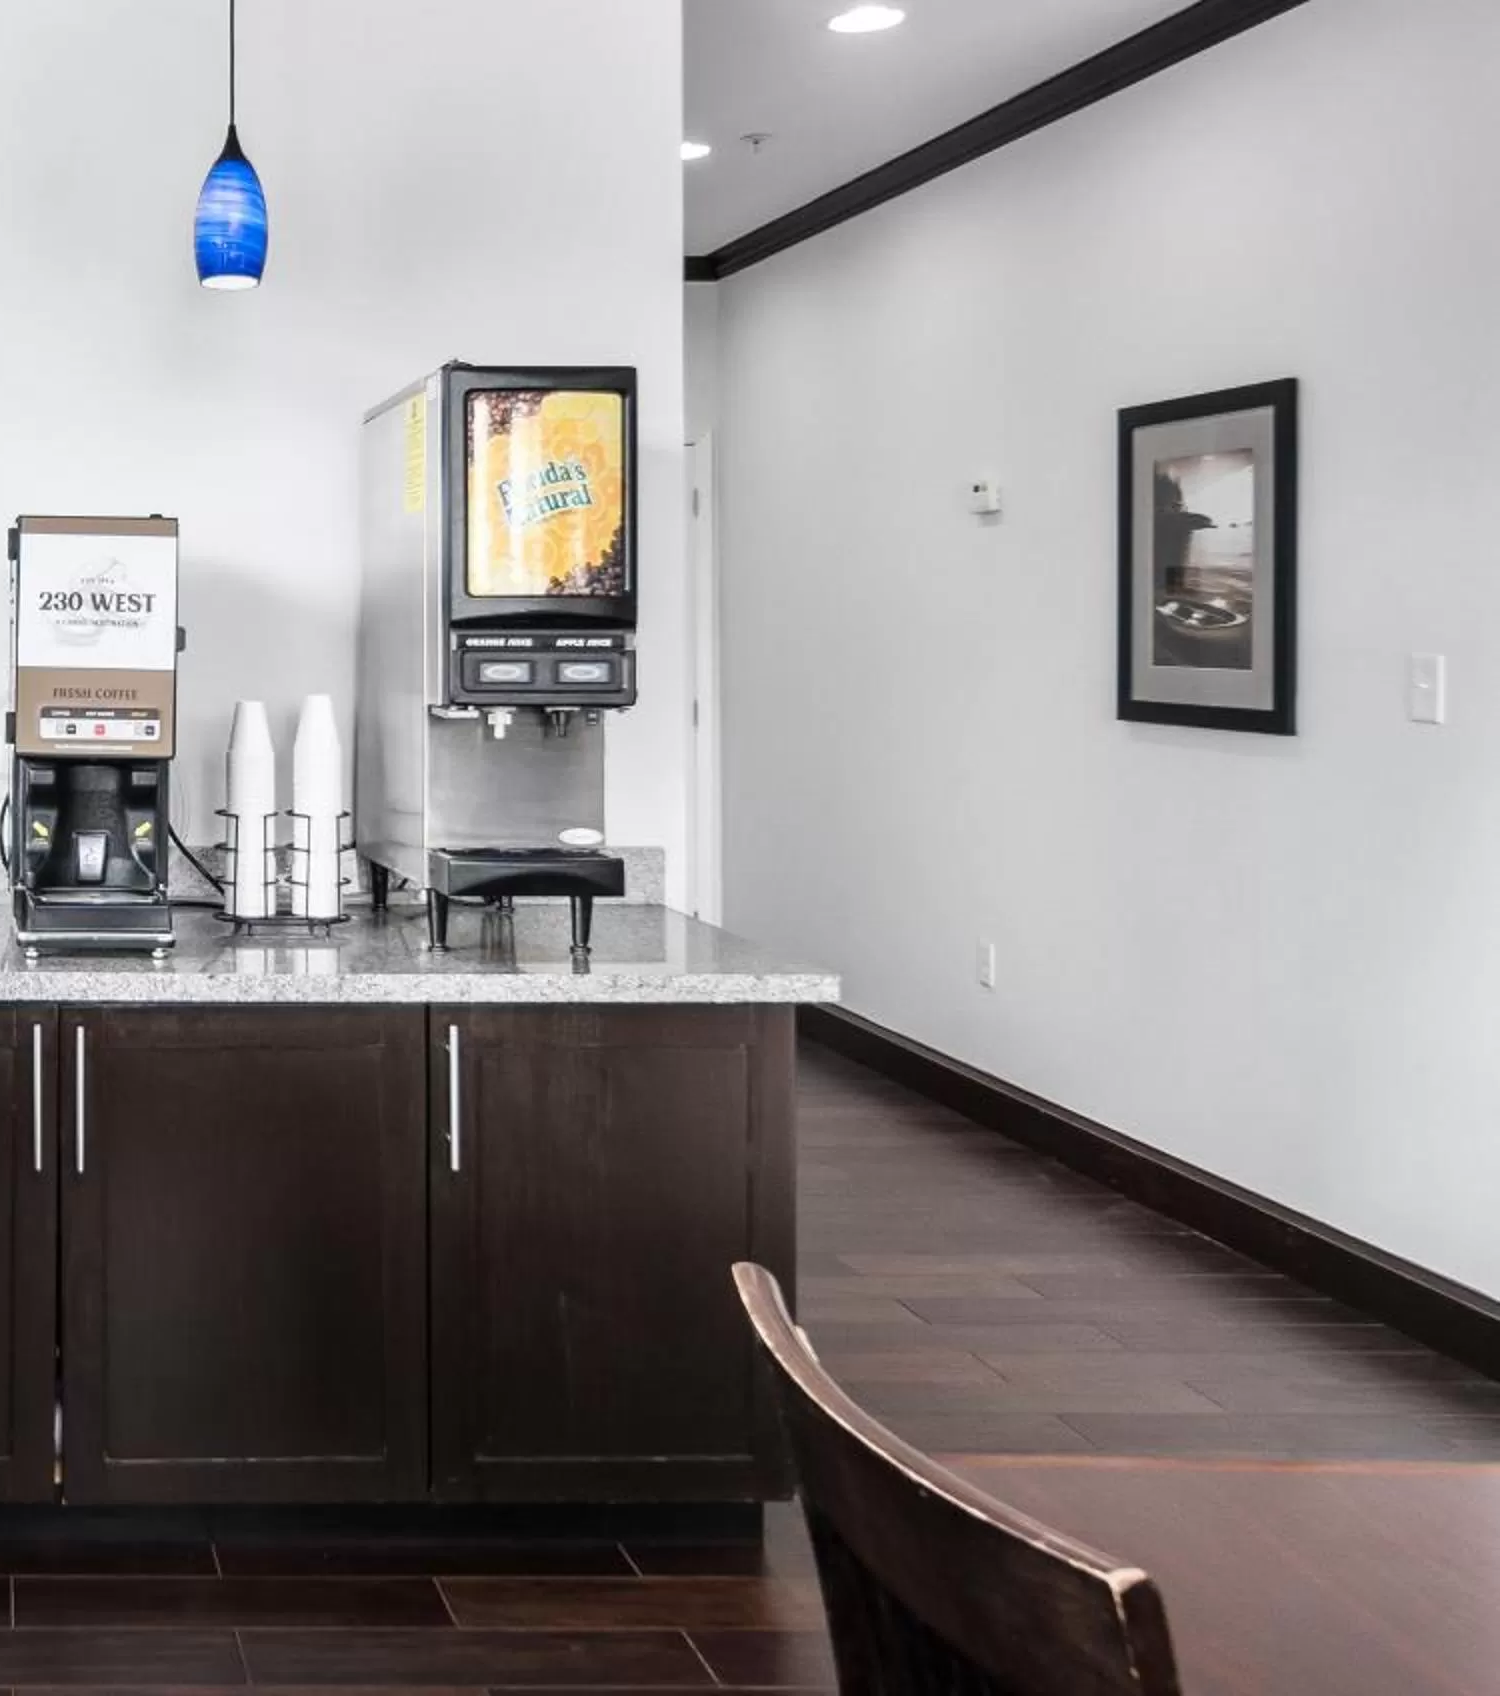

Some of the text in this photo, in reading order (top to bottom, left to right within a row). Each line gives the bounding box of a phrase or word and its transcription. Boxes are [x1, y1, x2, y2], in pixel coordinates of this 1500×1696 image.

[497, 461, 588, 508] Fida's
[505, 484, 593, 526] atural
[38, 591, 157, 613] 230 WEST
[52, 687, 138, 701] FRESH COFFEE
